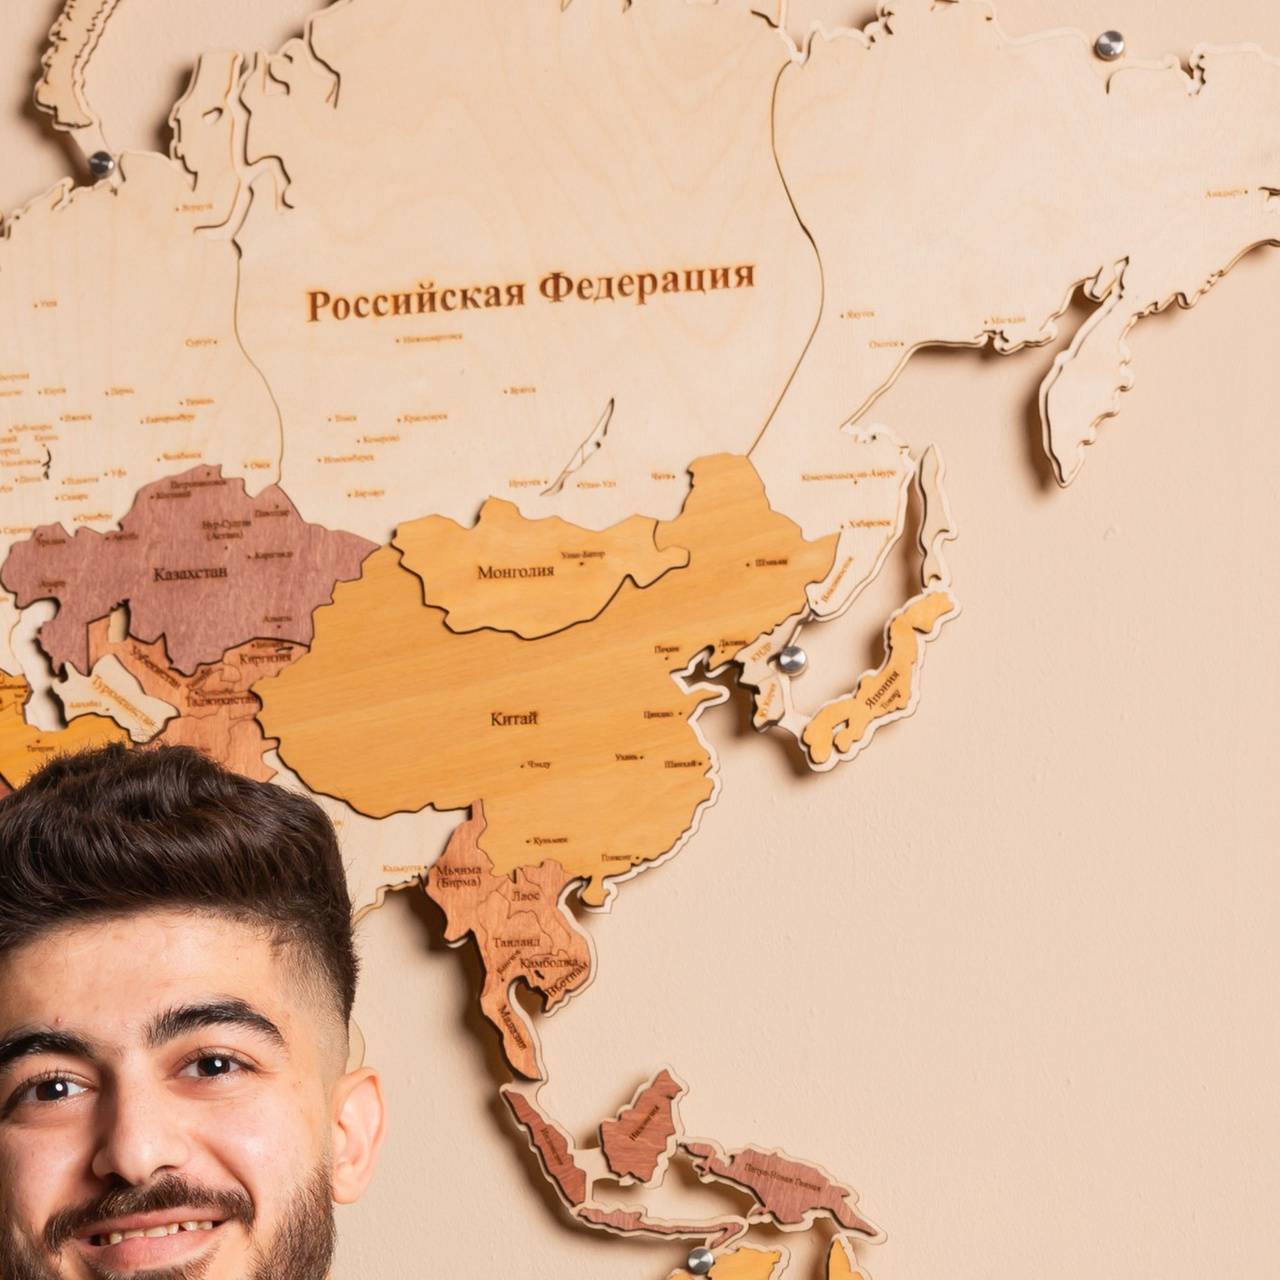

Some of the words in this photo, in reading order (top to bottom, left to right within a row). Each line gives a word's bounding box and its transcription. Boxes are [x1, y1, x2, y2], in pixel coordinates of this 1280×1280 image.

[306, 281, 527, 323] Российская
[538, 264, 756, 306] Федерация
[154, 566, 229, 583] Казахстан
[478, 565, 556, 580] Монголия
[822, 557, 853, 603] Владивосток
[240, 652, 293, 666] Киргизия
[751, 642, 773, 663] КНДР
[866, 671, 899, 709] Япония
[91, 674, 157, 727] Туркменистан
[490, 711, 539, 728] Китай
[437, 866, 482, 878] Мьянма
[437, 877, 482, 891] (Бирма)
[512, 890, 540, 902] Лаос
[493, 937, 540, 949] Таиланд
[520, 957, 579, 971] Камбоджа
[546, 963, 589, 999] Вьетнам
